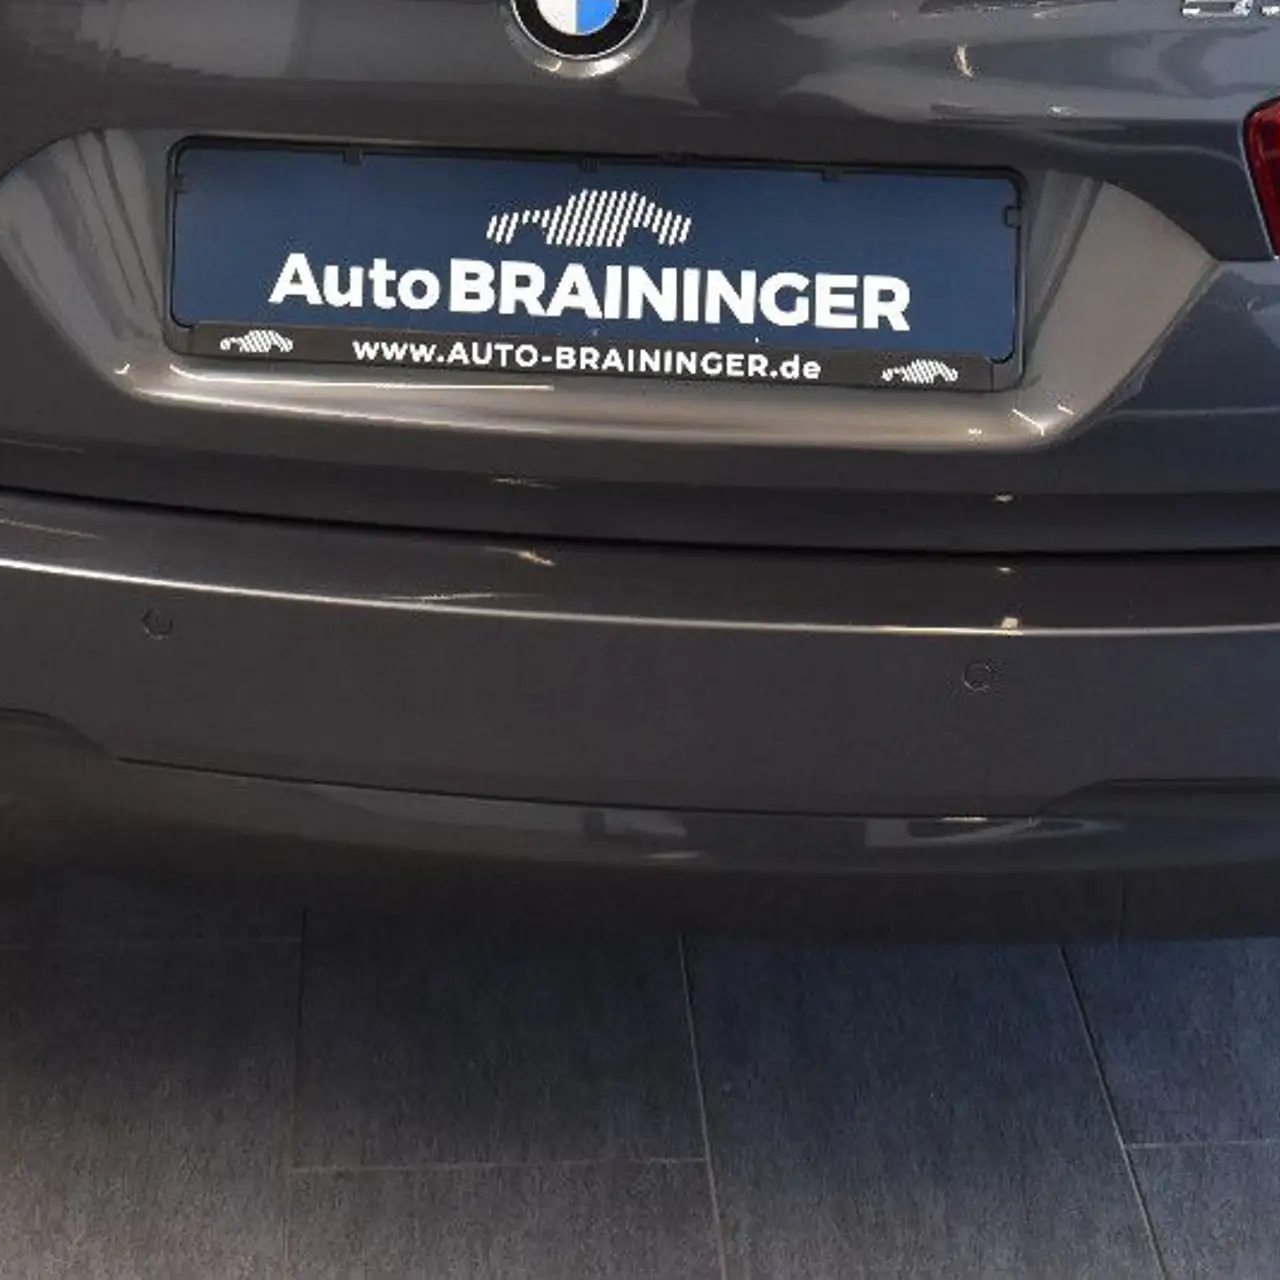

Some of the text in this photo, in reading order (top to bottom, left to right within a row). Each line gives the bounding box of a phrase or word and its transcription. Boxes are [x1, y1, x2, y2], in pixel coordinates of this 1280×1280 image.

[267, 252, 911, 332] Auto BRAININGER
[351, 339, 823, 381] www.AUTO-BRAININGER.de
